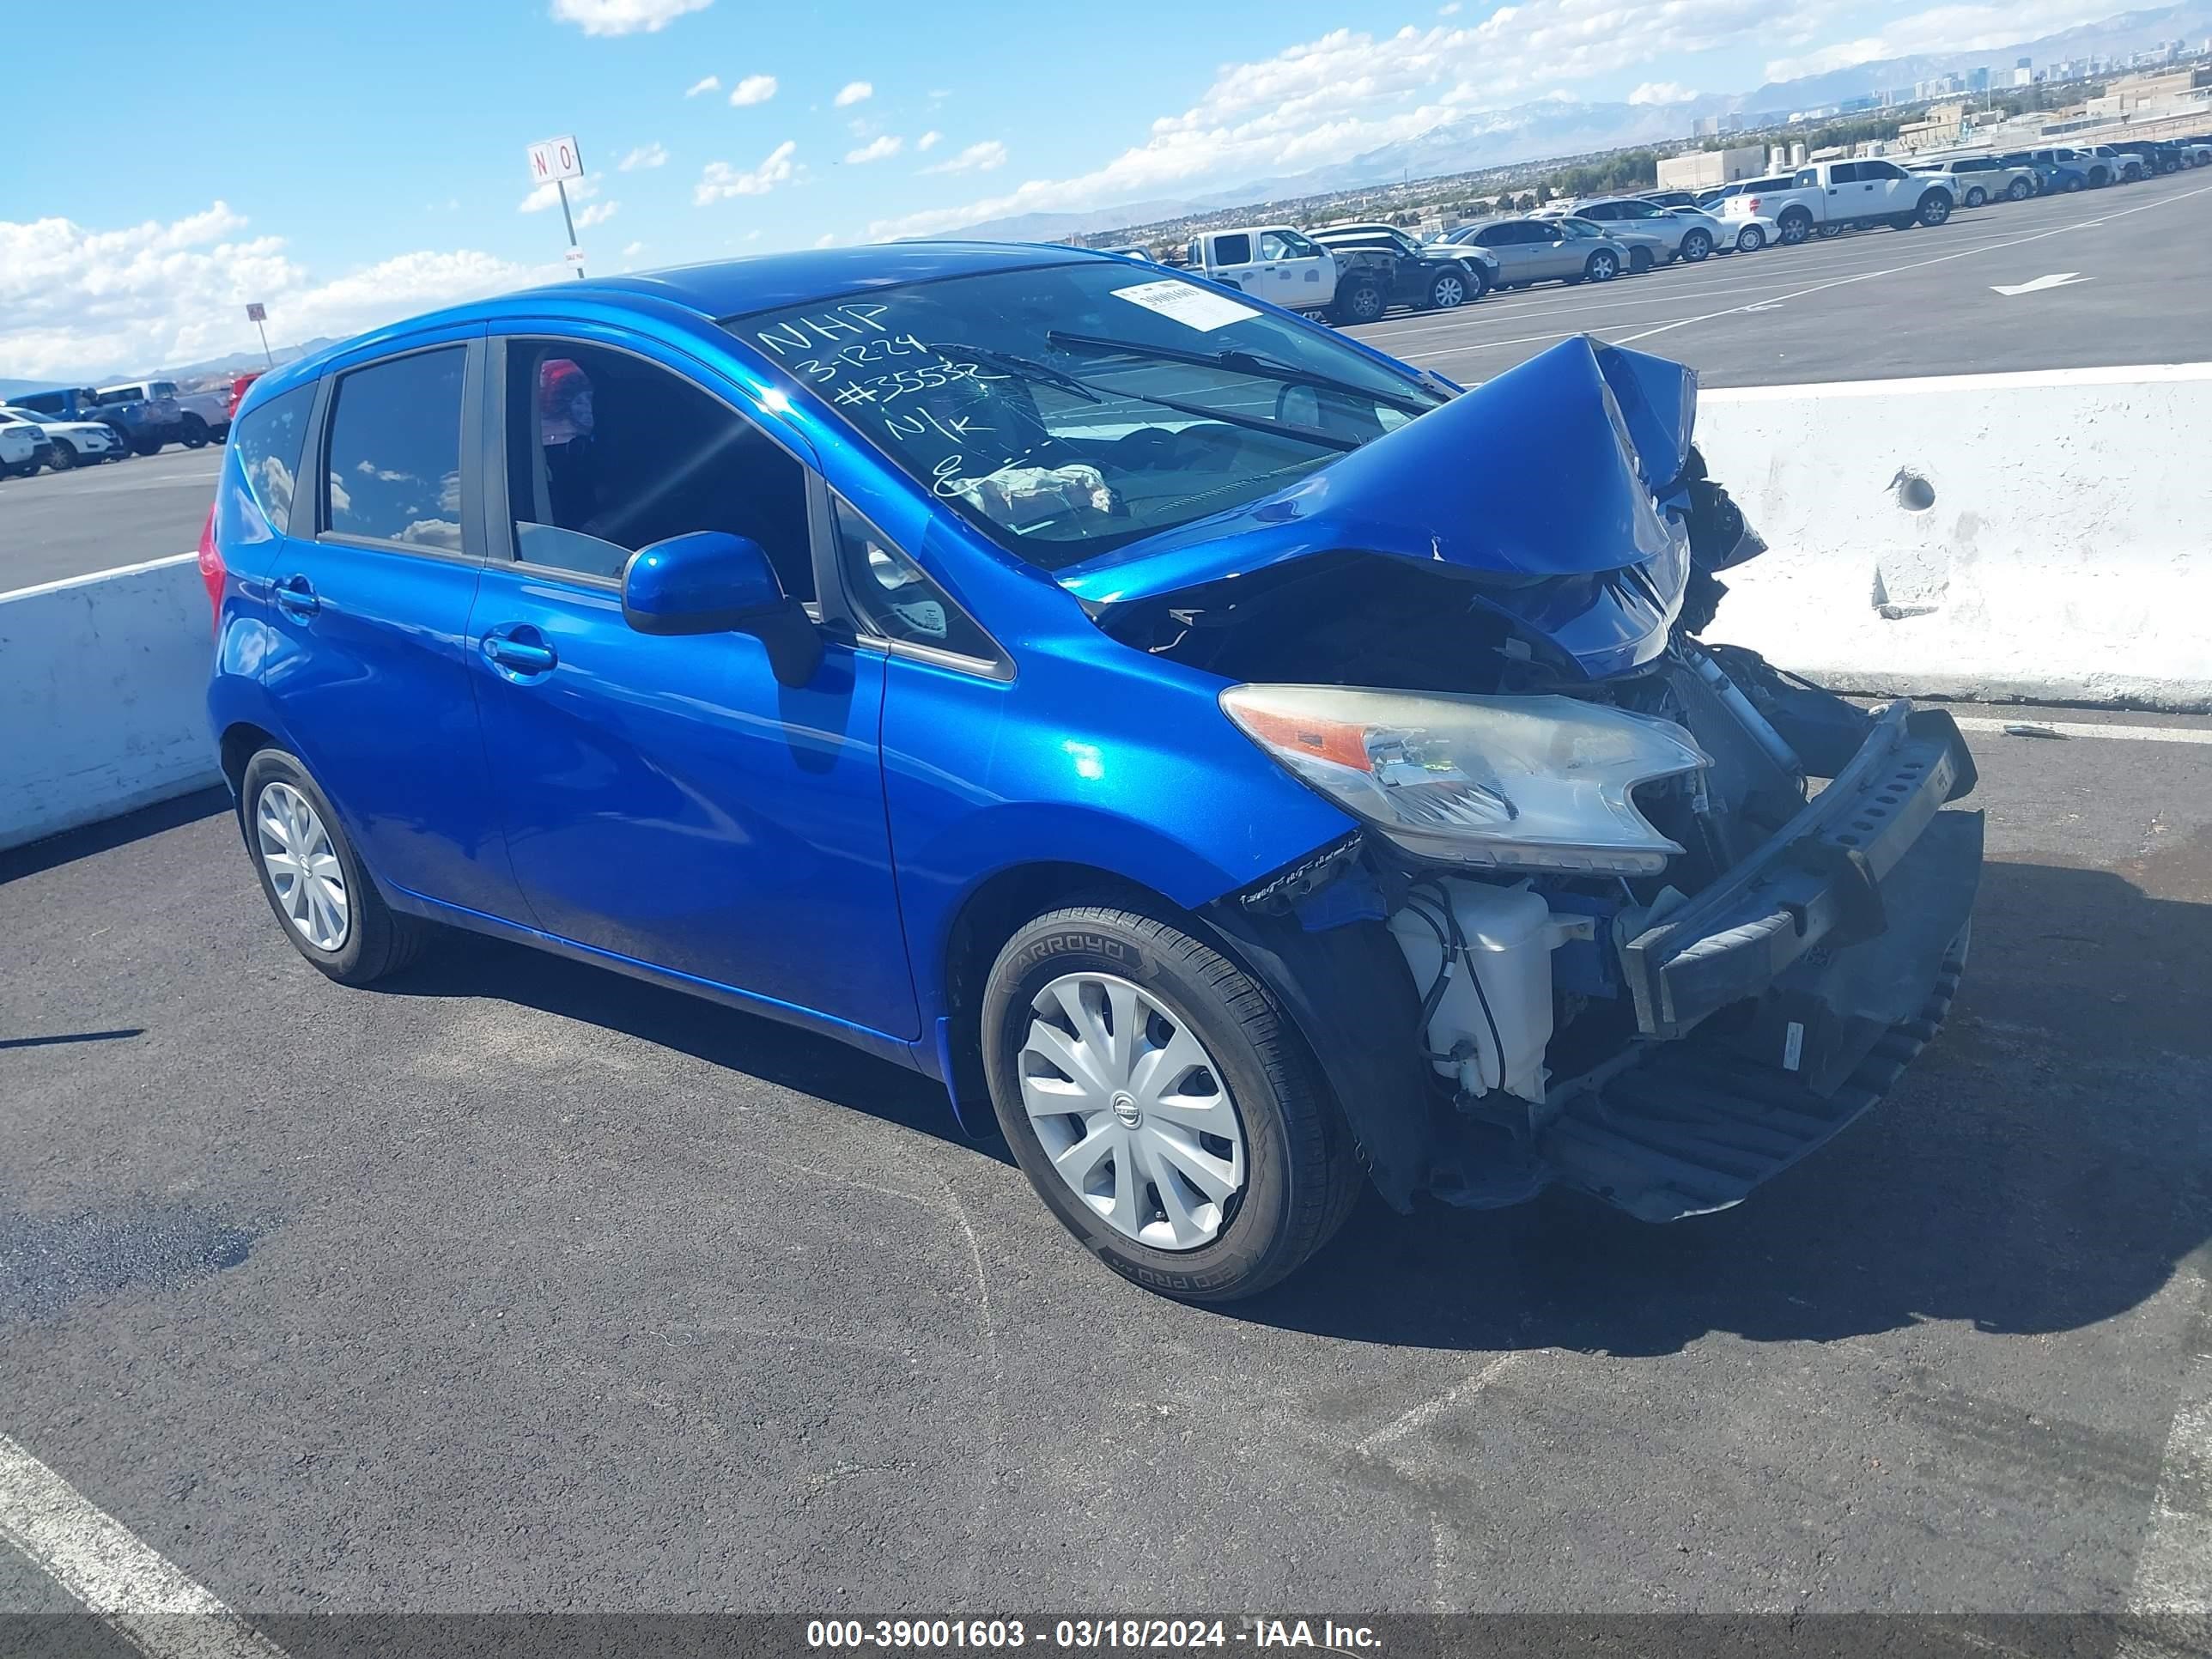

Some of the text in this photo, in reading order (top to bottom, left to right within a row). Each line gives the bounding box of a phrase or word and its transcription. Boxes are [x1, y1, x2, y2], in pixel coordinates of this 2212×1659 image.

[757, 303, 889, 356] NHP
[834, 362, 1012, 406] #35532
[1018, 934, 1125, 969] ARROYO
[1138, 1267, 1190, 1290] PRO
[1192, 1266, 1237, 1289] ECO
